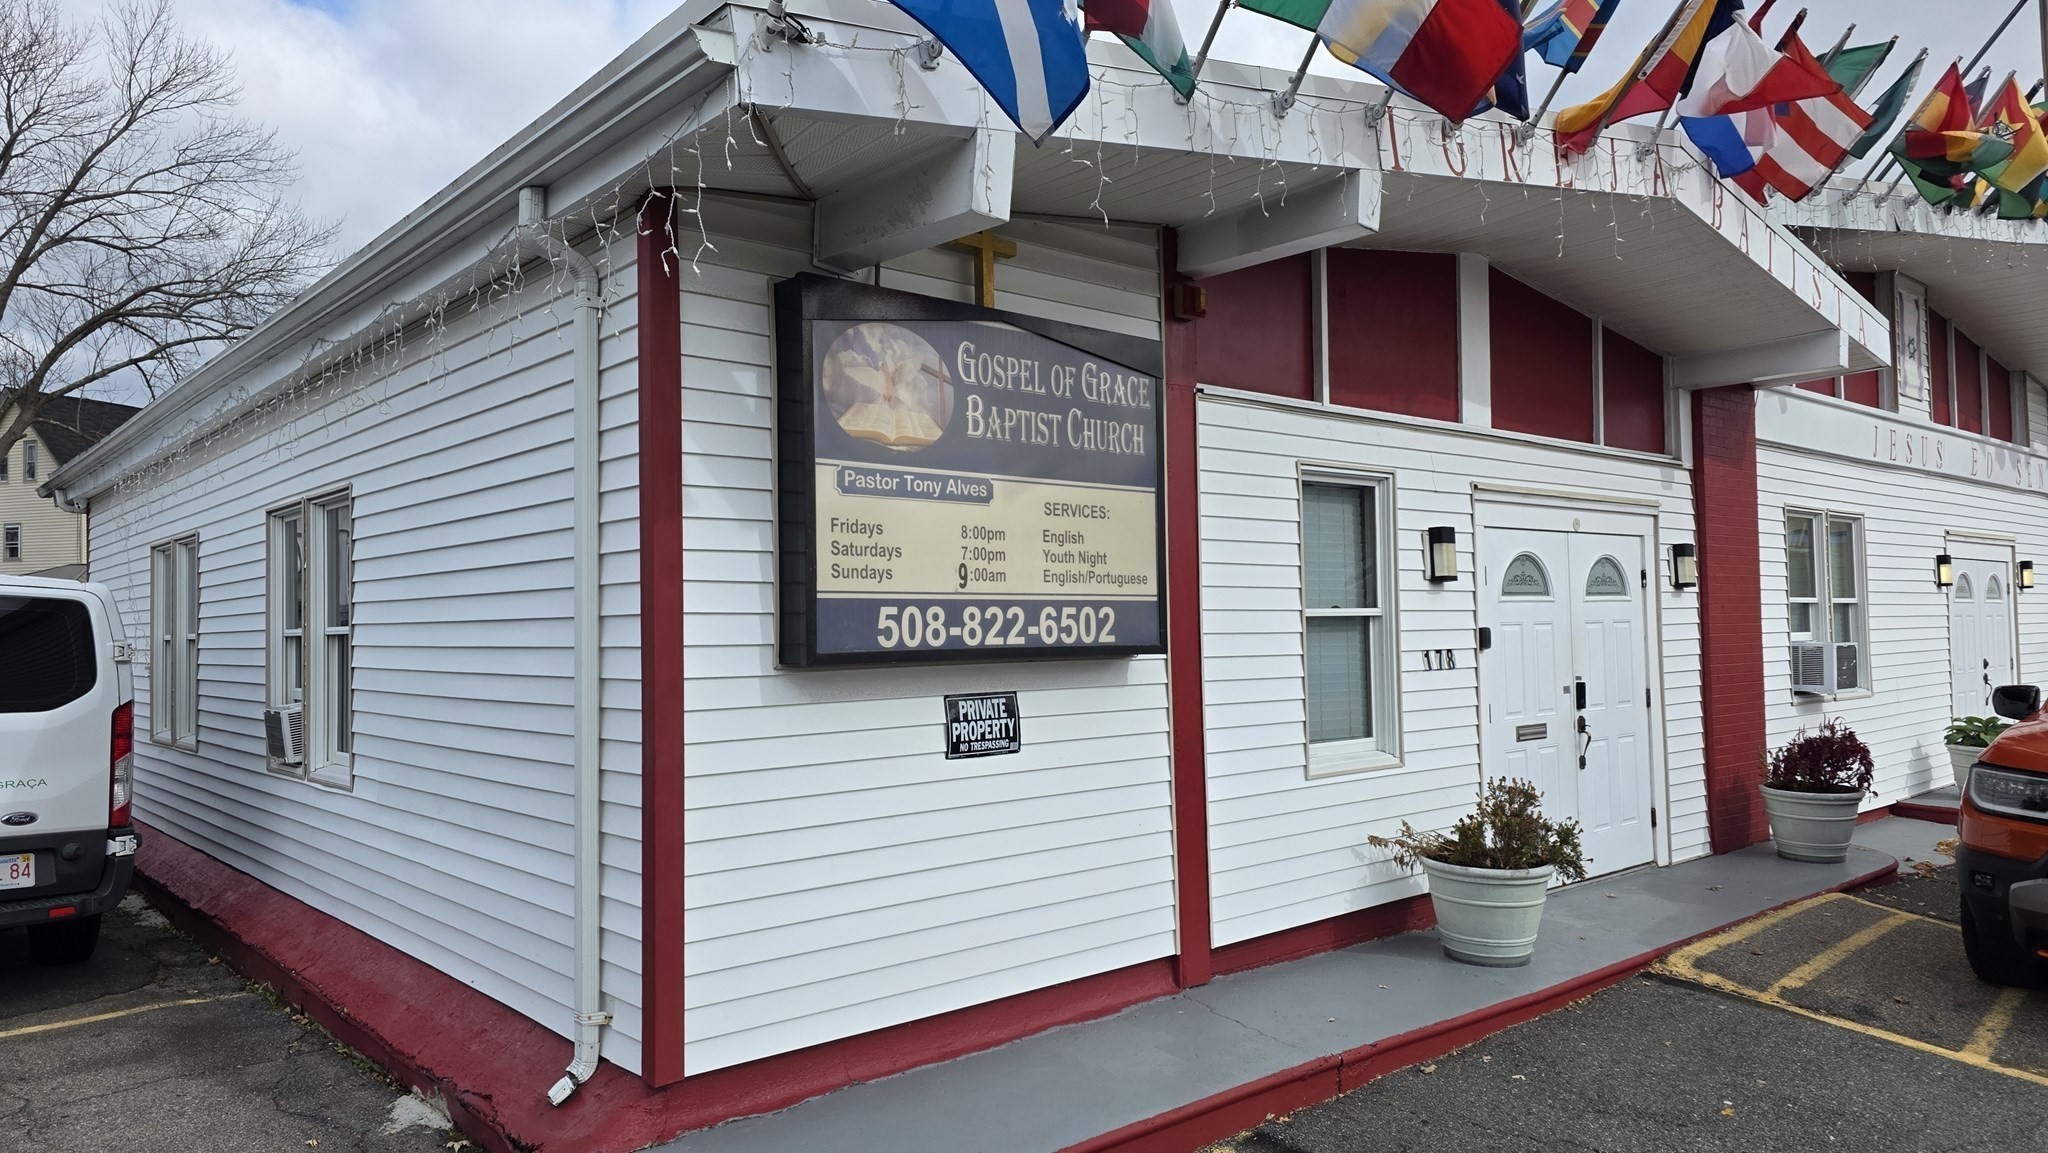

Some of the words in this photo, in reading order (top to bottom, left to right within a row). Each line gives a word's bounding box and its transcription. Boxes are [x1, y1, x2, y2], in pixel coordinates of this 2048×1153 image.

[1710, 177, 1867, 347] BATISTA
[1872, 425, 1943, 470] JESUS
[844, 470, 900, 491] Pastor
[904, 475, 942, 497] Tony
[946, 479, 988, 497] Alves
[1043, 501, 1110, 520] SERVICES:
[830, 517, 884, 539] Fridays
[960, 525, 1006, 544] 8:00pm
[1042, 529, 1085, 547] English
[831, 540, 902, 562] Saturdays
[961, 546, 1006, 565] 7:00pm
[1042, 549, 1075, 564] Youth
[1078, 550, 1107, 568] Night
[831, 563, 893, 584] Sundays
[958, 562, 1007, 589] 9:00am
[1043, 569, 1148, 588] English/Portuguese
[877, 605, 1116, 649] 508-822-6502
[1423, 649, 1456, 671] 178
[958, 698, 1008, 721] PRIVATE
[952, 718, 1015, 743] PROPERTY
[960, 742, 969, 752] NO
[970, 739, 1009, 752] TRESPASSING
[9, 862, 31, 880] 84
